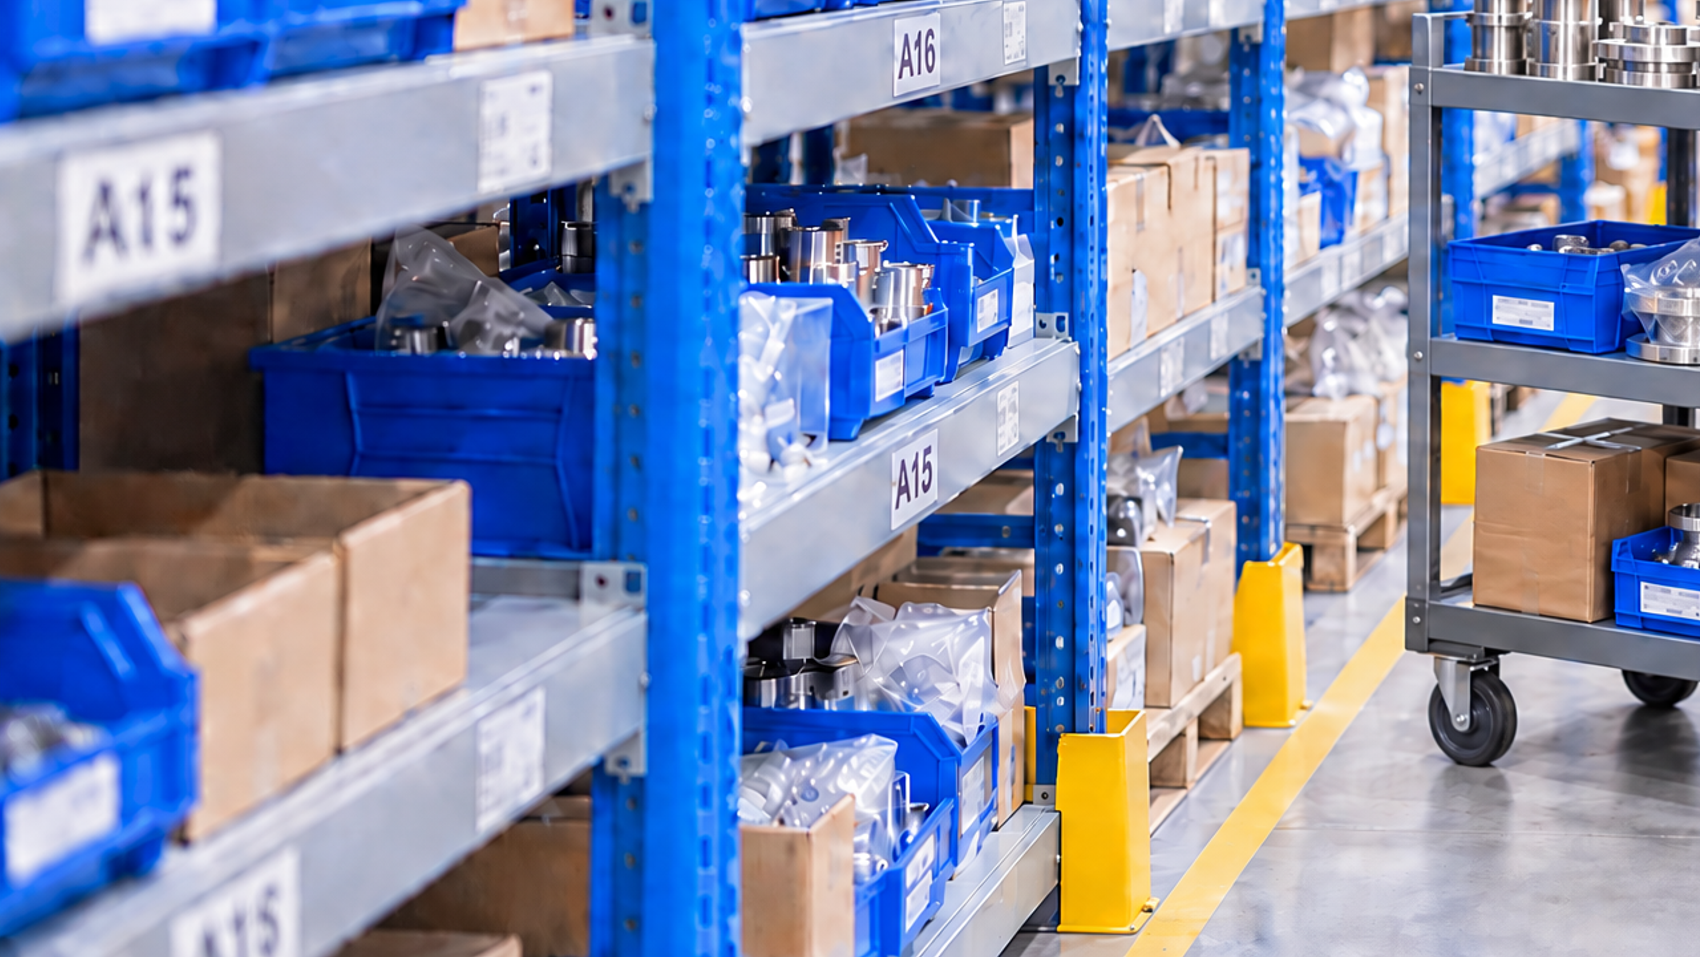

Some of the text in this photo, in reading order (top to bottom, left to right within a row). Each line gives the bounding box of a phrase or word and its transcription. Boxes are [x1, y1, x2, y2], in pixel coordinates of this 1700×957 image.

[897, 27, 936, 80] A16
[80, 164, 198, 263] A15
[894, 443, 934, 510] A15
